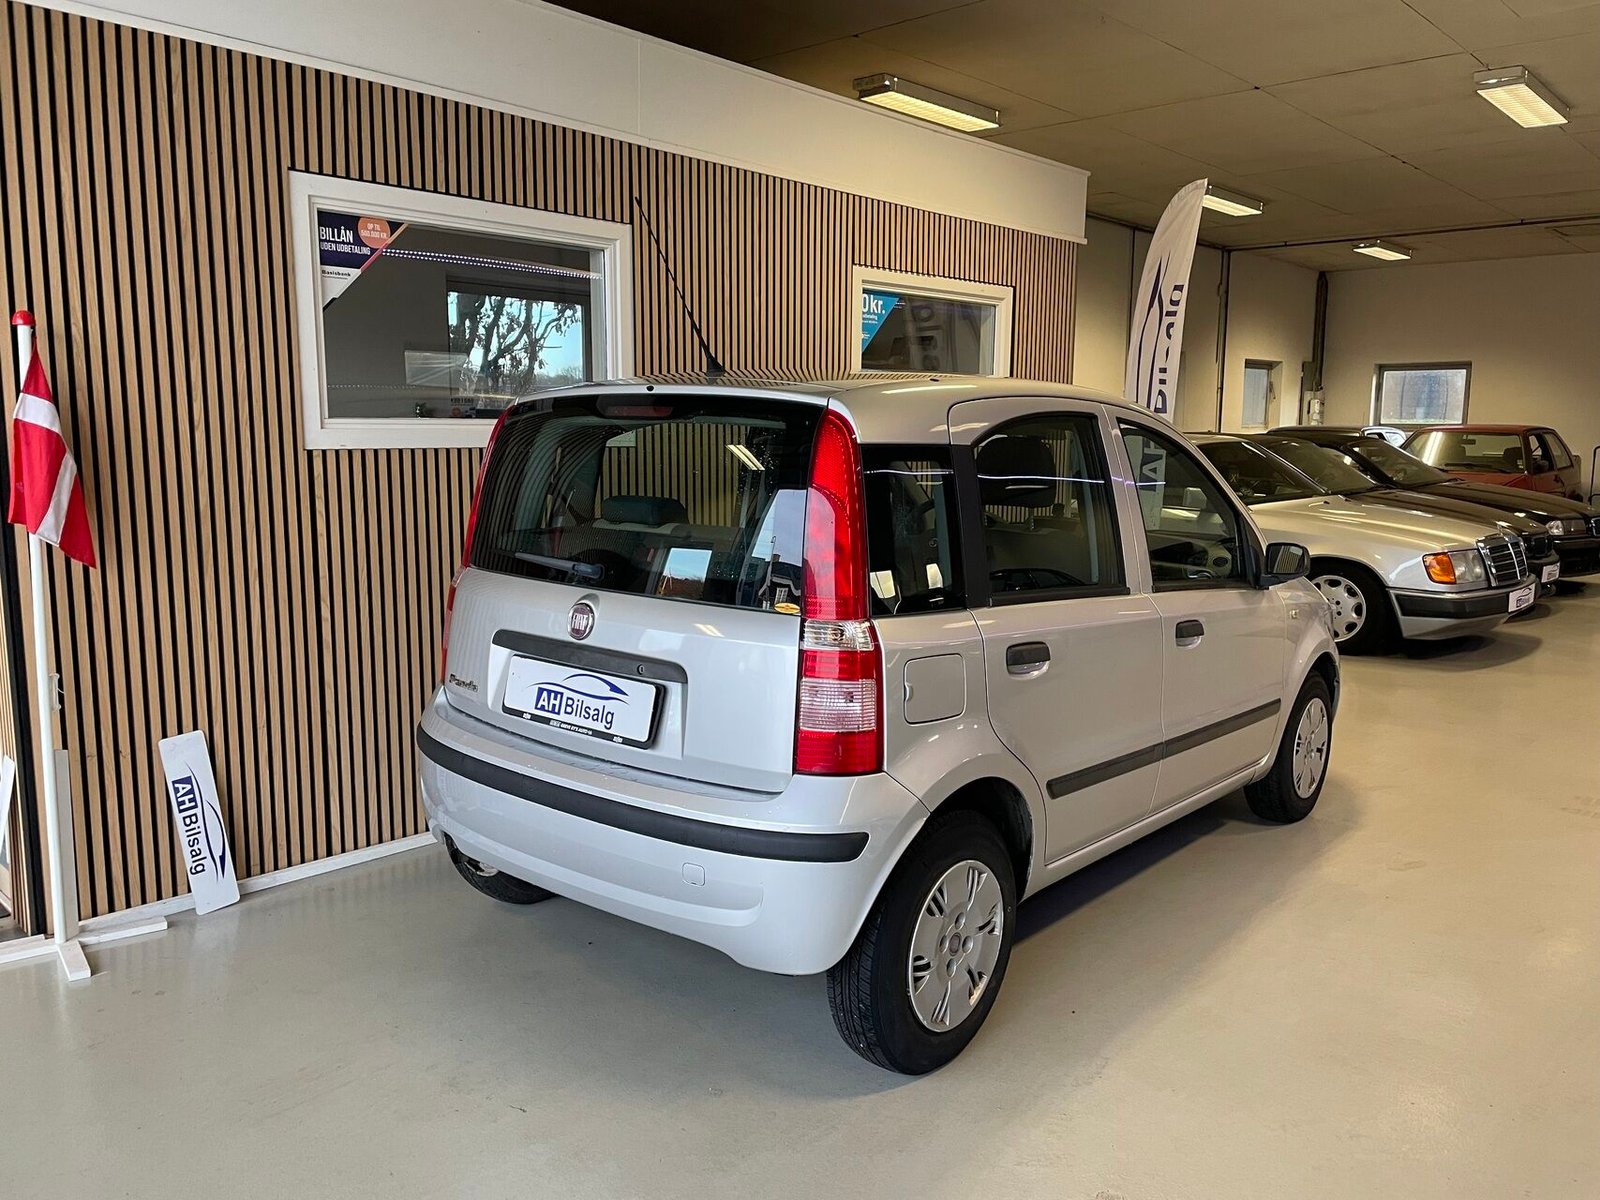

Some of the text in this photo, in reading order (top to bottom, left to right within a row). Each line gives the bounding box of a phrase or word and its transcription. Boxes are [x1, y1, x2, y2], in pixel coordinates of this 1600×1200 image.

[320, 226, 353, 243] BILLÅN
[320, 242, 371, 255] UDEN UDBETALING
[538, 692, 559, 713] AH
[564, 697, 614, 730] Bilsalg
[174, 783, 207, 876] AH Bilsalg
